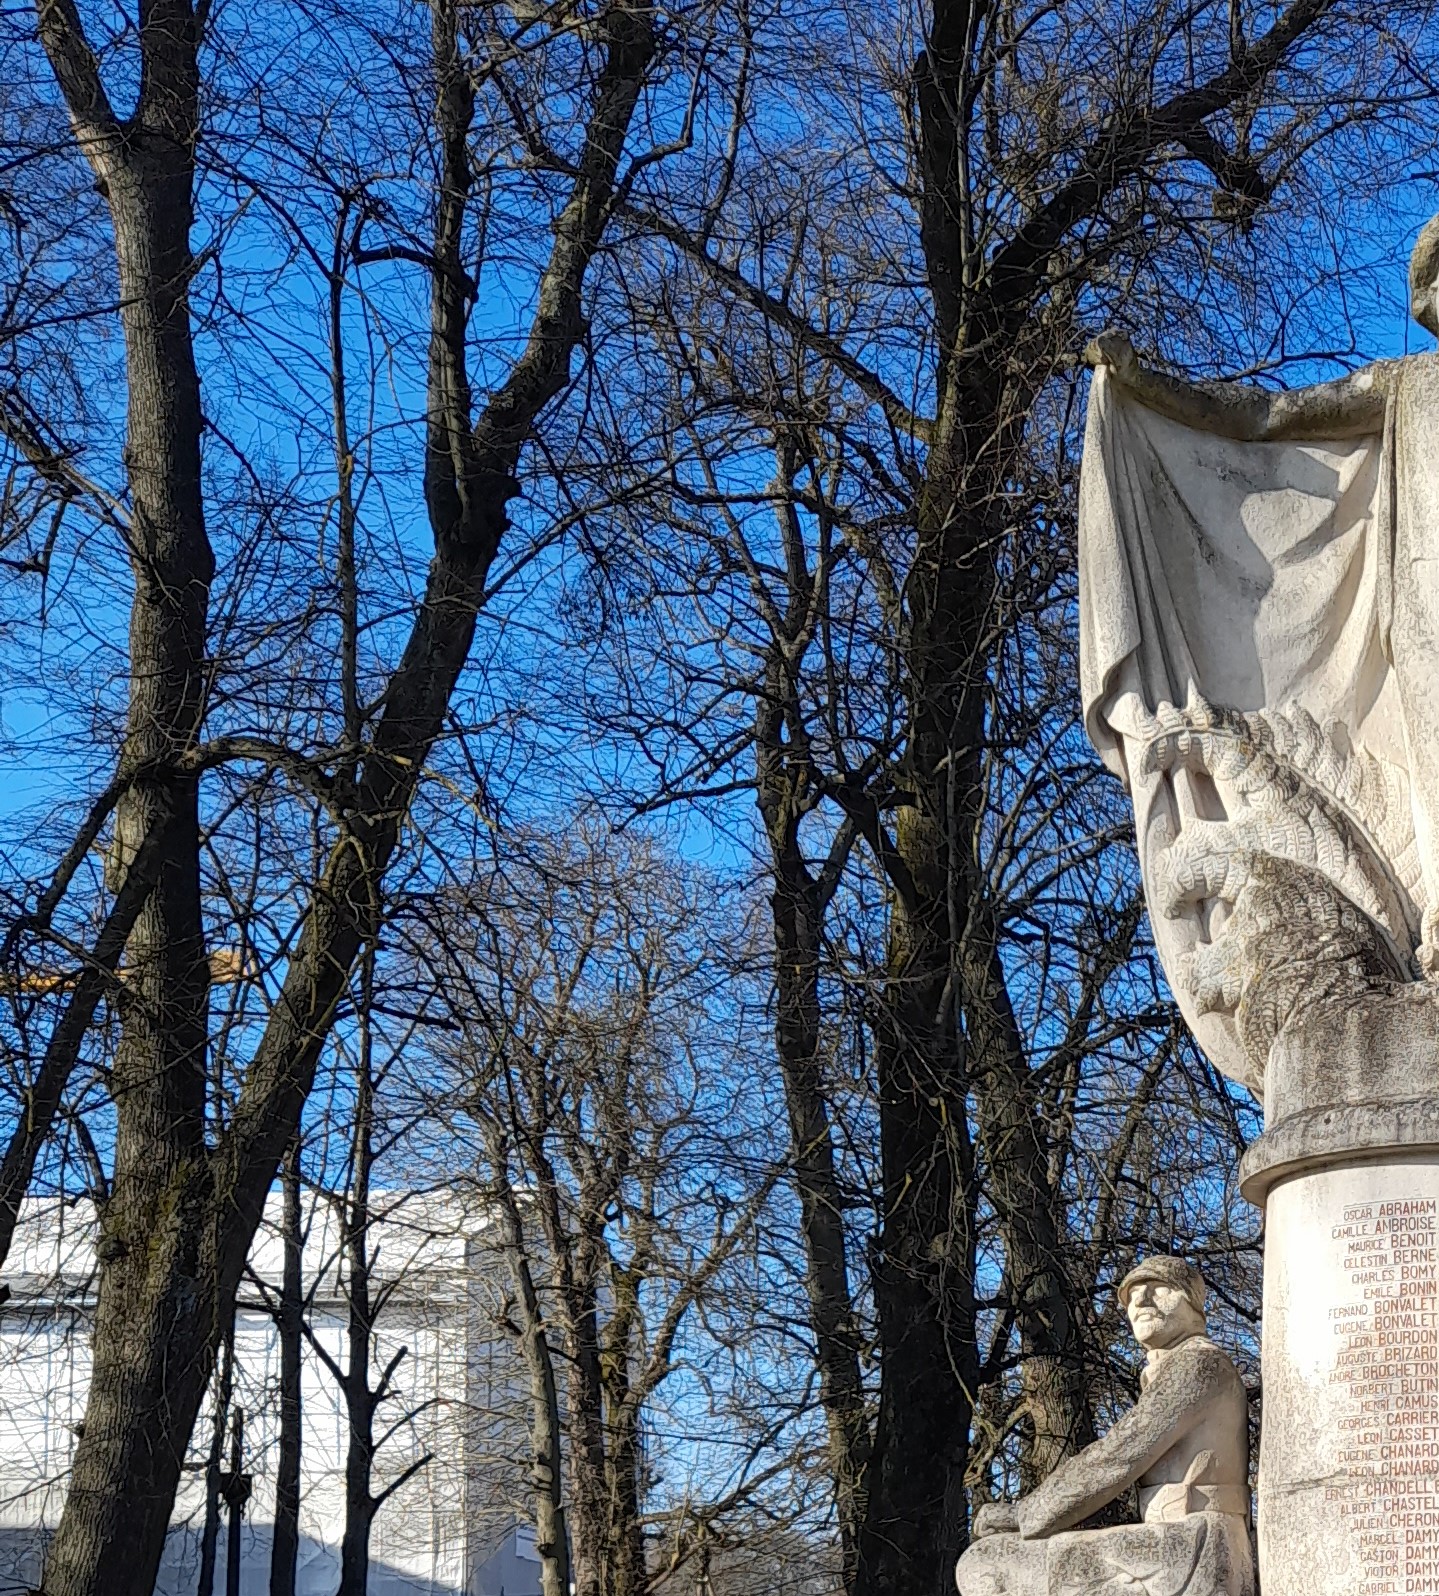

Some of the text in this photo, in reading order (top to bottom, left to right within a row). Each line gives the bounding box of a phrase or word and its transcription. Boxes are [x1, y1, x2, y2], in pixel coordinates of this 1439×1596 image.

[1344, 1200, 1436, 1221] OSCAR ABRAHAM
[1375, 1217, 1436, 1235] AMBROISE
[1391, 1232, 1436, 1248] BENOIT
[1394, 1249, 1436, 1264] BERNE
[1401, 1265, 1436, 1279] BOMY
[1400, 1281, 1436, 1296] BONIN
[1375, 1297, 1437, 1314] BONVALET
[1375, 1313, 1437, 1330] BONVALET
[1379, 1330, 1437, 1346] BOURDON
[1385, 1346, 1437, 1360] BRIZARD
[1363, 1362, 1438, 1379] BROCHETON
[1401, 1378, 1438, 1393] BUTIN
[1396, 1395, 1438, 1409] CAMUS
[1387, 1411, 1439, 1426] CARRIER
[1390, 1427, 1439, 1441] CASSET
[1381, 1443, 1439, 1459] CHANARD
[1381, 1460, 1439, 1477] CHANARD
[1384, 1497, 1439, 1511] CHASTEL
[1390, 1513, 1439, 1527] CHERON
[1406, 1529, 1439, 1543] DAMY
[1406, 1545, 1439, 1559] DAMY
[1406, 1562, 1439, 1575] DAMY
